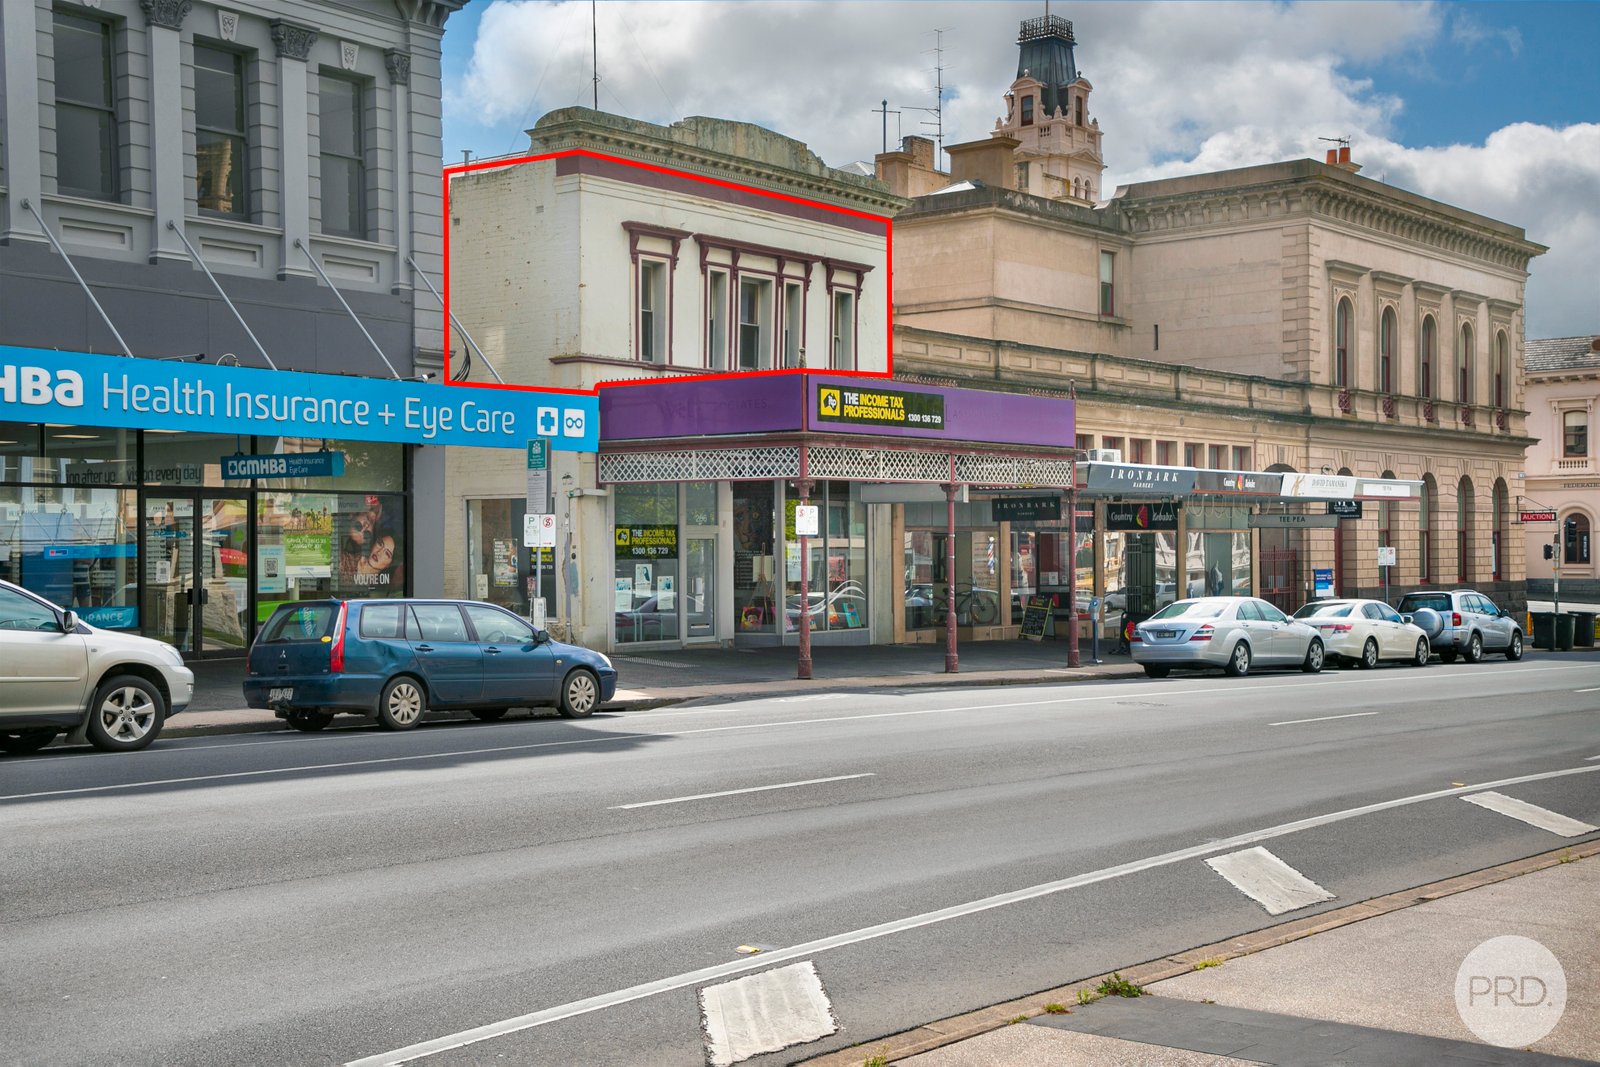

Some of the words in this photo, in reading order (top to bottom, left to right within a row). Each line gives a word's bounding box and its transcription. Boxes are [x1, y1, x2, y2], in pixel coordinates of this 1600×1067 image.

[102, 372, 216, 417] Health
[226, 382, 370, 426] Insurance
[404, 397, 453, 439] Eye
[460, 401, 516, 434] Care
[844, 392, 859, 405] THE
[859, 394, 890, 408] INCOME
[890, 396, 904, 409] TAX
[844, 406, 905, 421] PROFESSIONALS
[908, 413, 921, 422] 1300
[922, 414, 932, 423] 136
[932, 415, 942, 423] 729
[289, 457, 304, 467] Health
[156, 467, 182, 484] every
[183, 465, 201, 483] day
[1110, 468, 1179, 482] IRONBARK
[997, 501, 1056, 509] IRONBARK
[1111, 512, 1133, 523] Country
[1522, 512, 1552, 520] AUCTION
[632, 529, 643, 537] THE
[643, 529, 665, 537] INCOME
[665, 529, 676, 537] TAX
[632, 537, 677, 545] PROFESSIONALS
[632, 547, 646, 555] 1300
[353, 573, 379, 586] YOU'RE
[379, 573, 390, 585] ON
